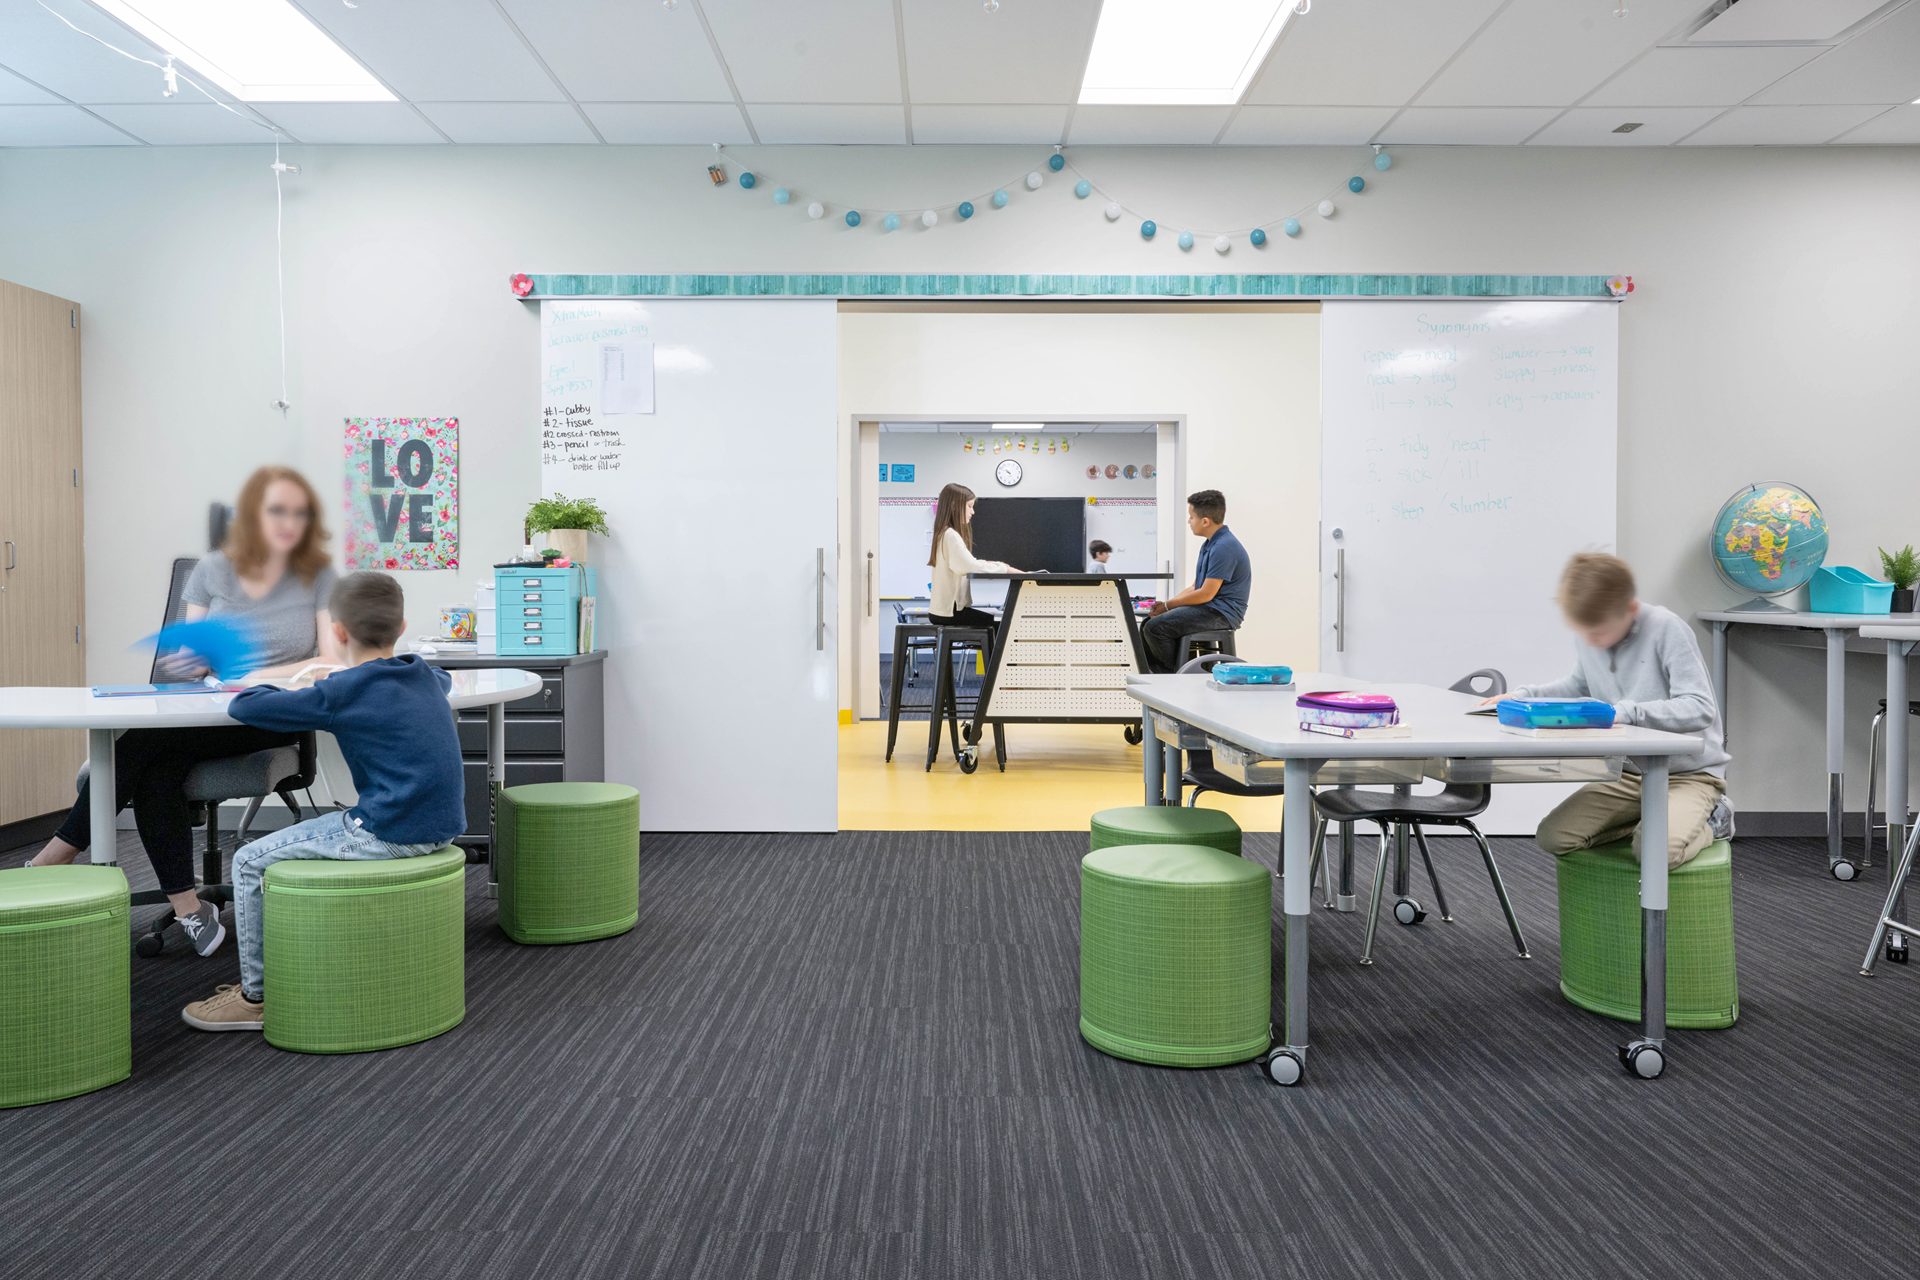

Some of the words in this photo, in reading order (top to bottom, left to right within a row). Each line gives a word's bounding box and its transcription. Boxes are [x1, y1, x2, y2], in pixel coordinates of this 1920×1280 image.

[1416, 313, 1491, 341] Synonyms
[1363, 348, 1402, 368] repair
[1425, 344, 1457, 361] mend
[1366, 367, 1399, 386] neat
[1430, 366, 1457, 392] tidy
[1558, 363, 1597, 381] messy
[1423, 393, 1453, 408] sick
[1487, 390, 1524, 412] reply
[1399, 433, 1430, 460] tidy
[1451, 429, 1491, 453] neat
[371, 439, 434, 489] LO
[1398, 467, 1432, 483] sick
[1459, 459, 1480, 479] ill
[368, 494, 434, 543] VE
[1391, 501, 1425, 525] sleep
[1449, 492, 1513, 517] slumber
